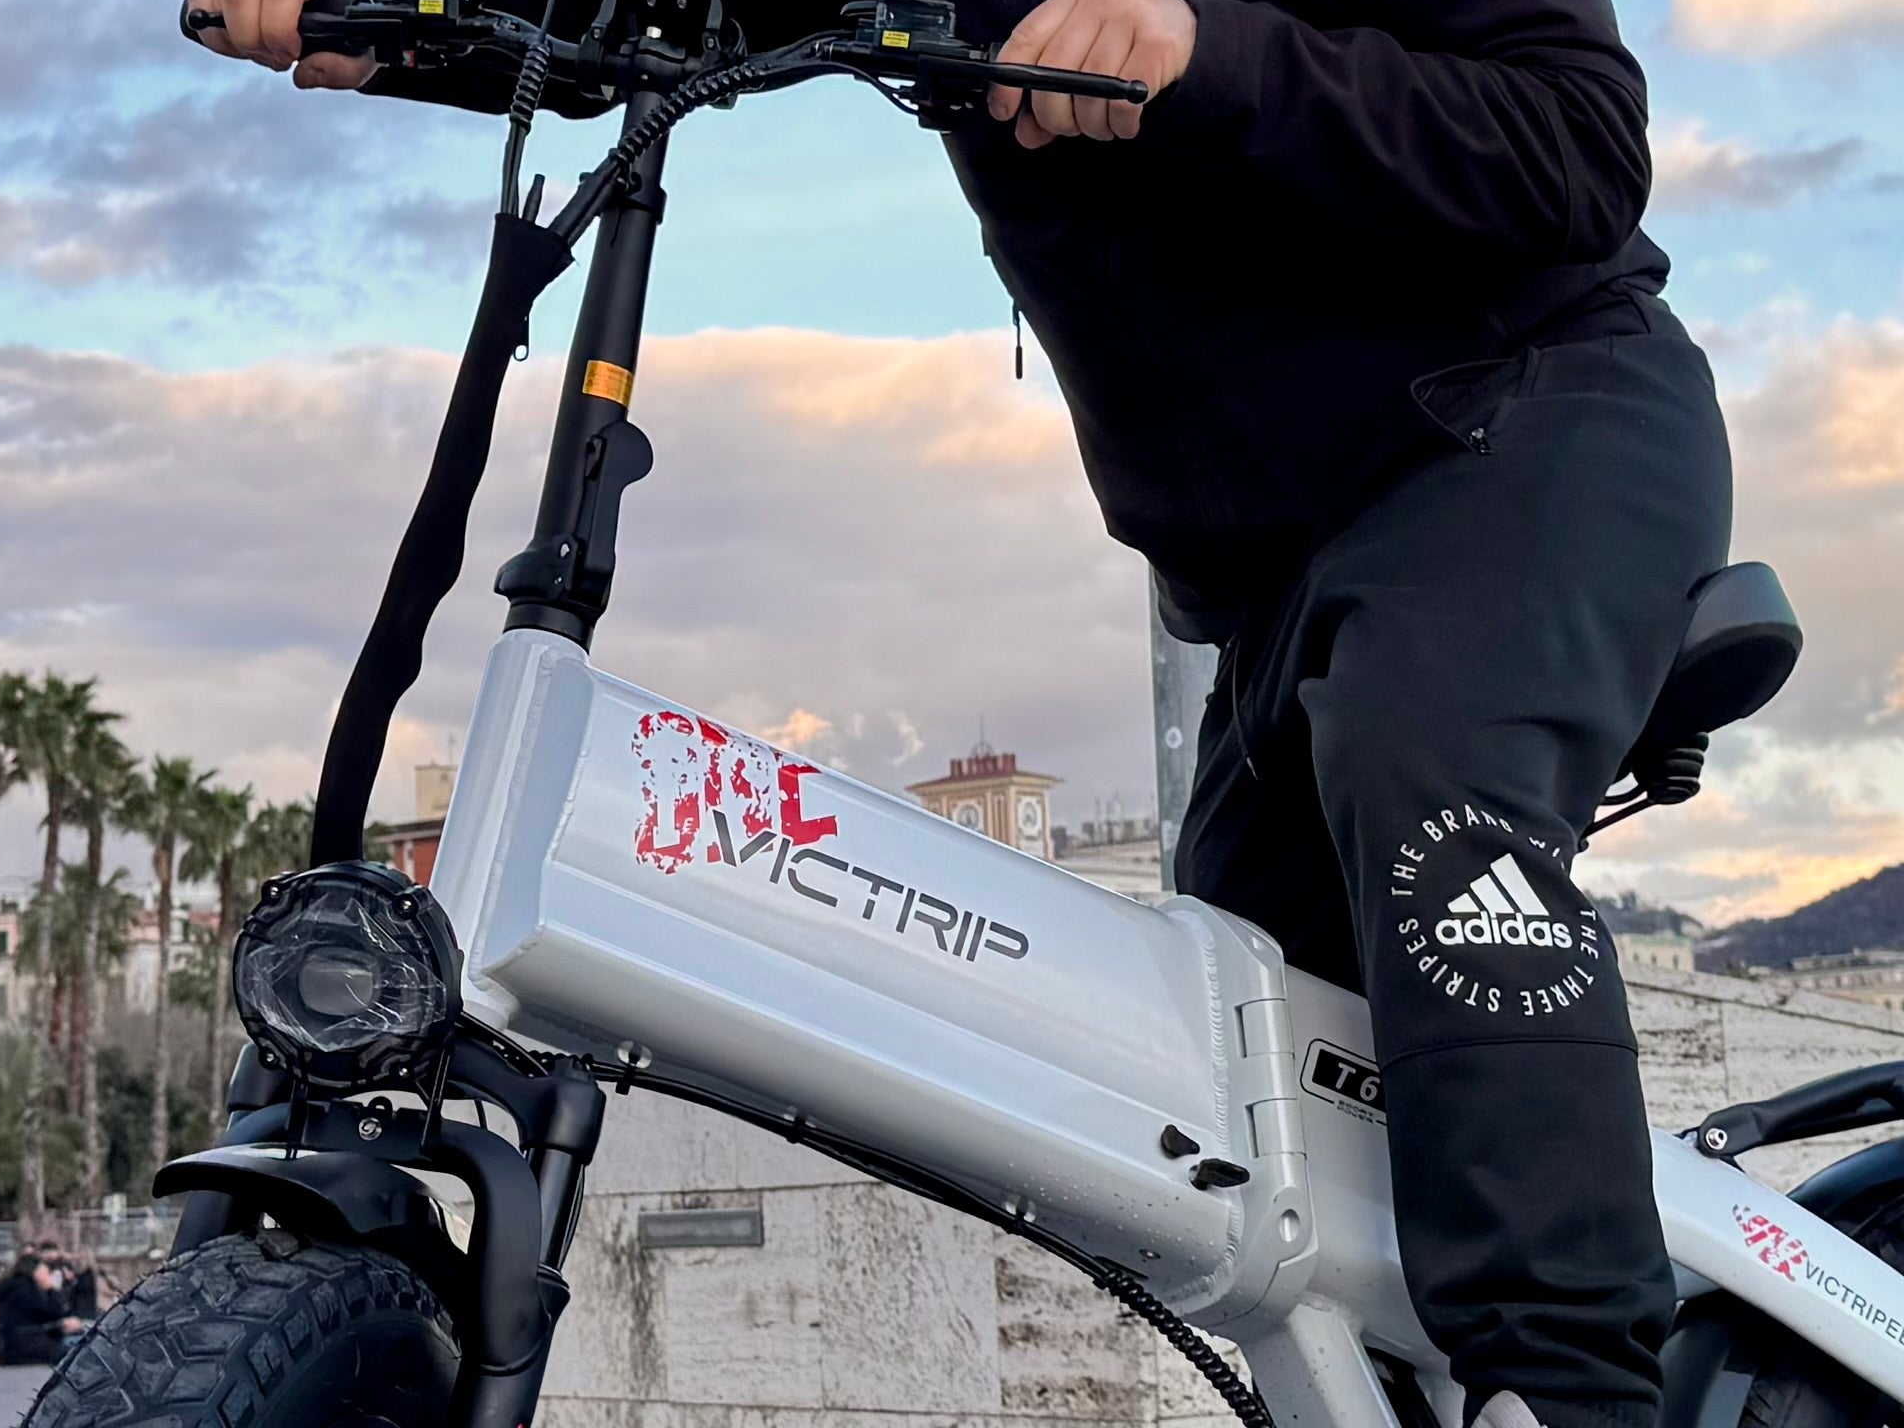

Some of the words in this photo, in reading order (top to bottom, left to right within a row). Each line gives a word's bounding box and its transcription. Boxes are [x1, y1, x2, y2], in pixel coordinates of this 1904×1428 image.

[712, 808, 1030, 963] VICTRIP
[1391, 843, 1425, 896] THE
[1434, 909, 1574, 949] adidas
[1579, 909, 1599, 960] THE
[1398, 918, 1502, 1012] STRIPES
[1520, 965, 1595, 1016] THREE
